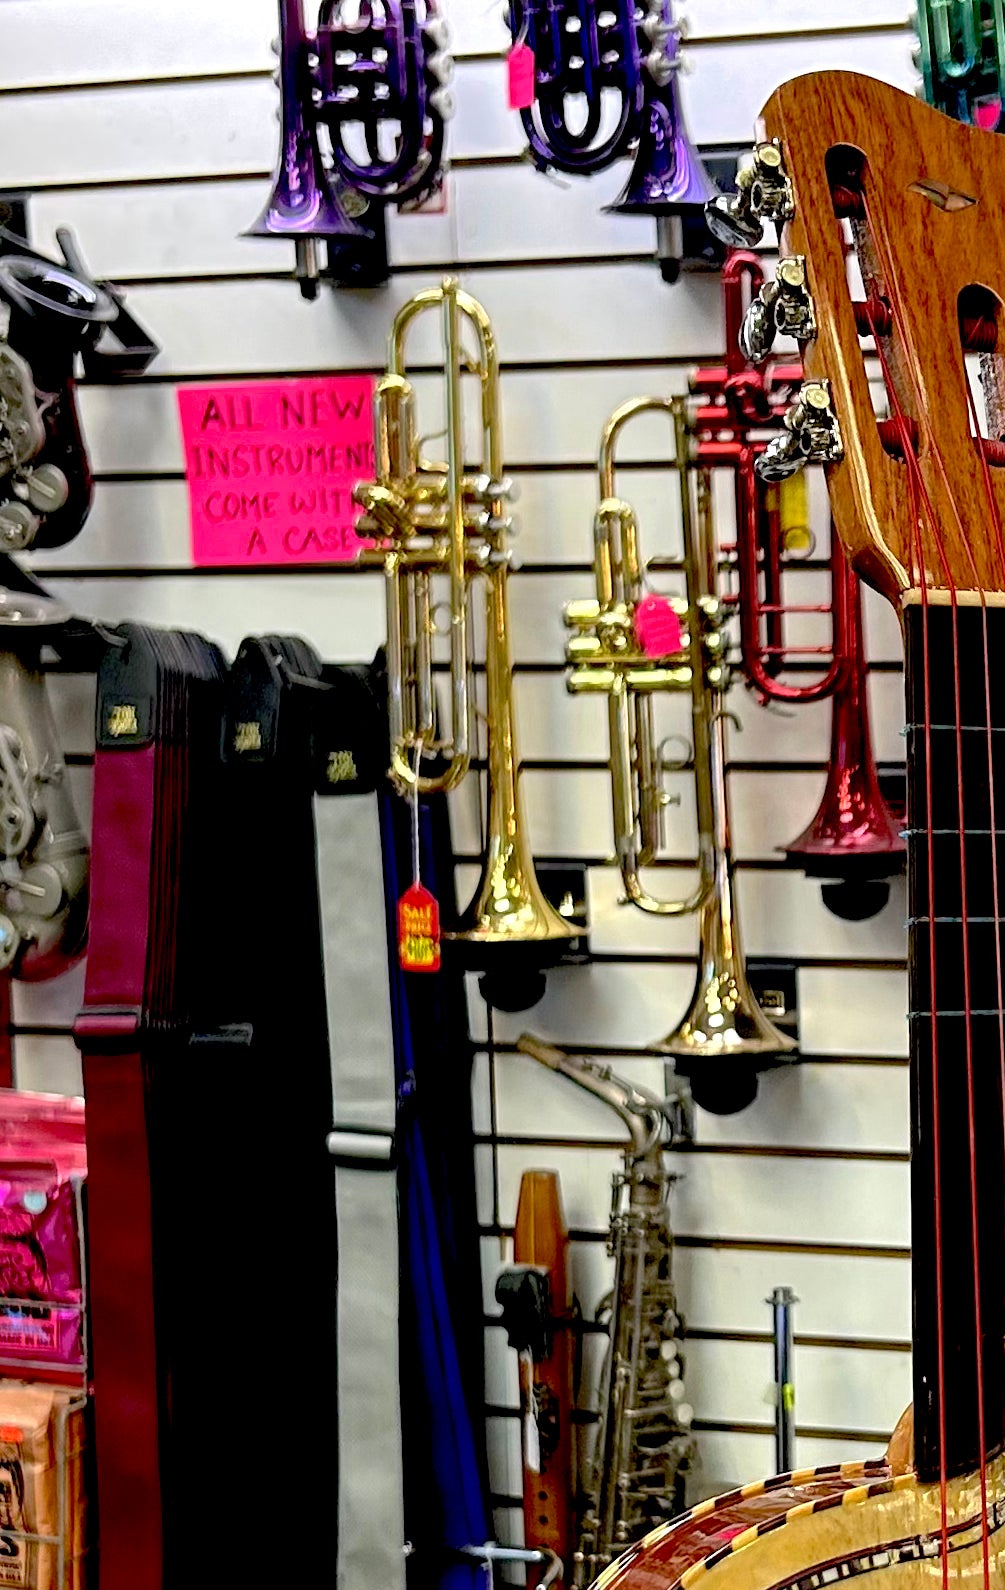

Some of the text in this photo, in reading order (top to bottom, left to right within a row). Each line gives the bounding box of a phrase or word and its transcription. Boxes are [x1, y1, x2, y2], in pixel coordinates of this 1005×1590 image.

[201, 388, 365, 431] ALL NEW
[192, 441, 374, 478] INSTRUMENT
[205, 489, 280, 524] COME
[246, 525, 355, 557] A CASE
